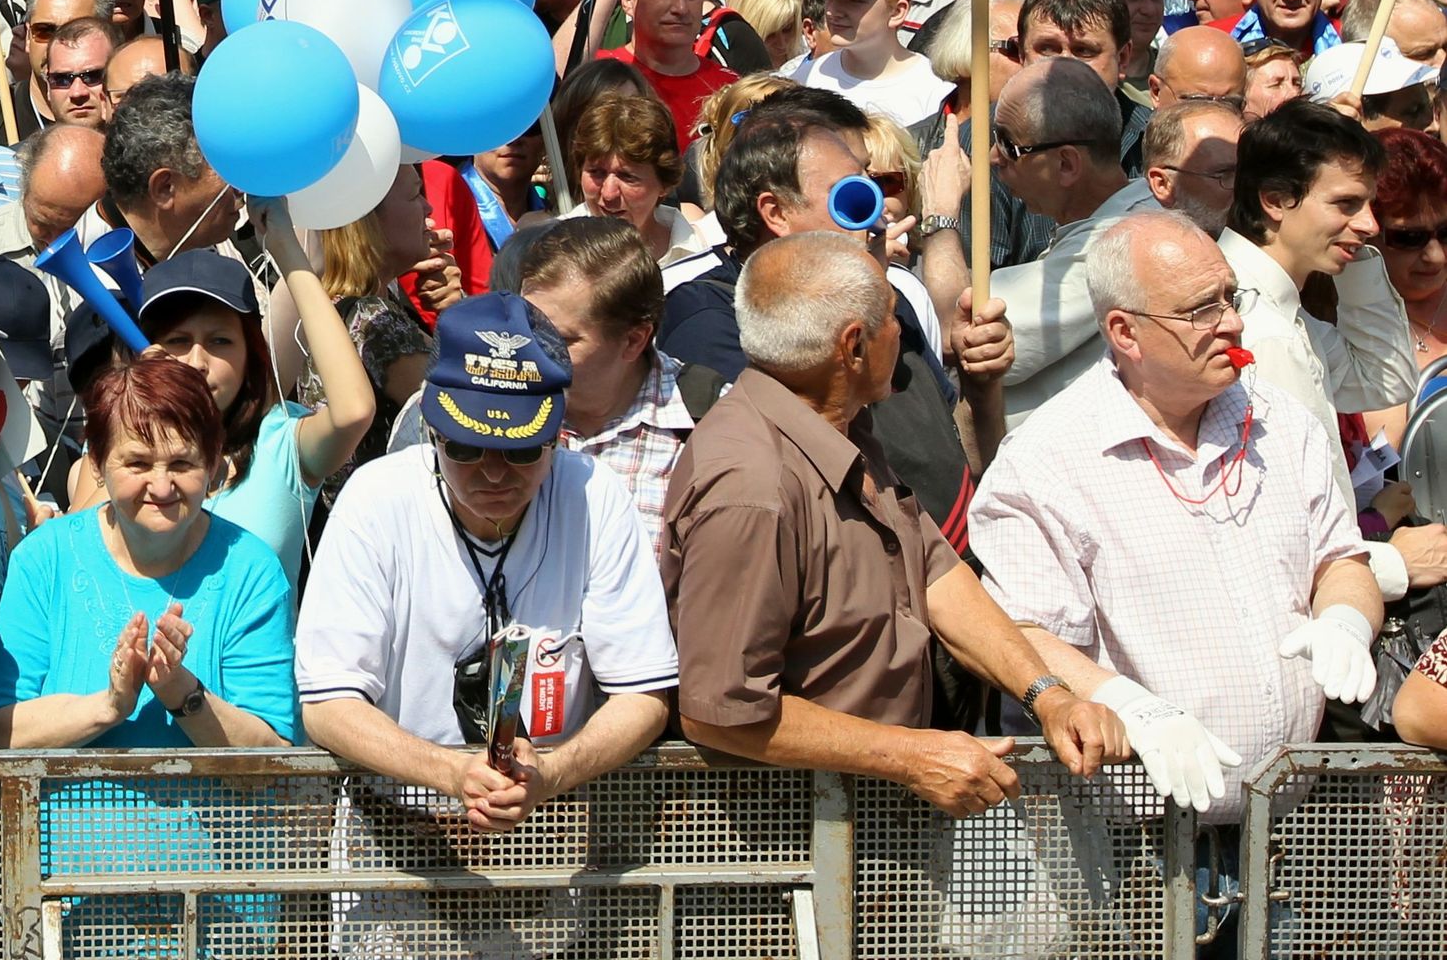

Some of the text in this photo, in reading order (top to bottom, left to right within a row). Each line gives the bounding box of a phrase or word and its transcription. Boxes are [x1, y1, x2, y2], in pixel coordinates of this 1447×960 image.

[464, 353, 543, 382] USA
[470, 376, 529, 390] CALIFORNIA
[486, 409, 511, 421] USA
